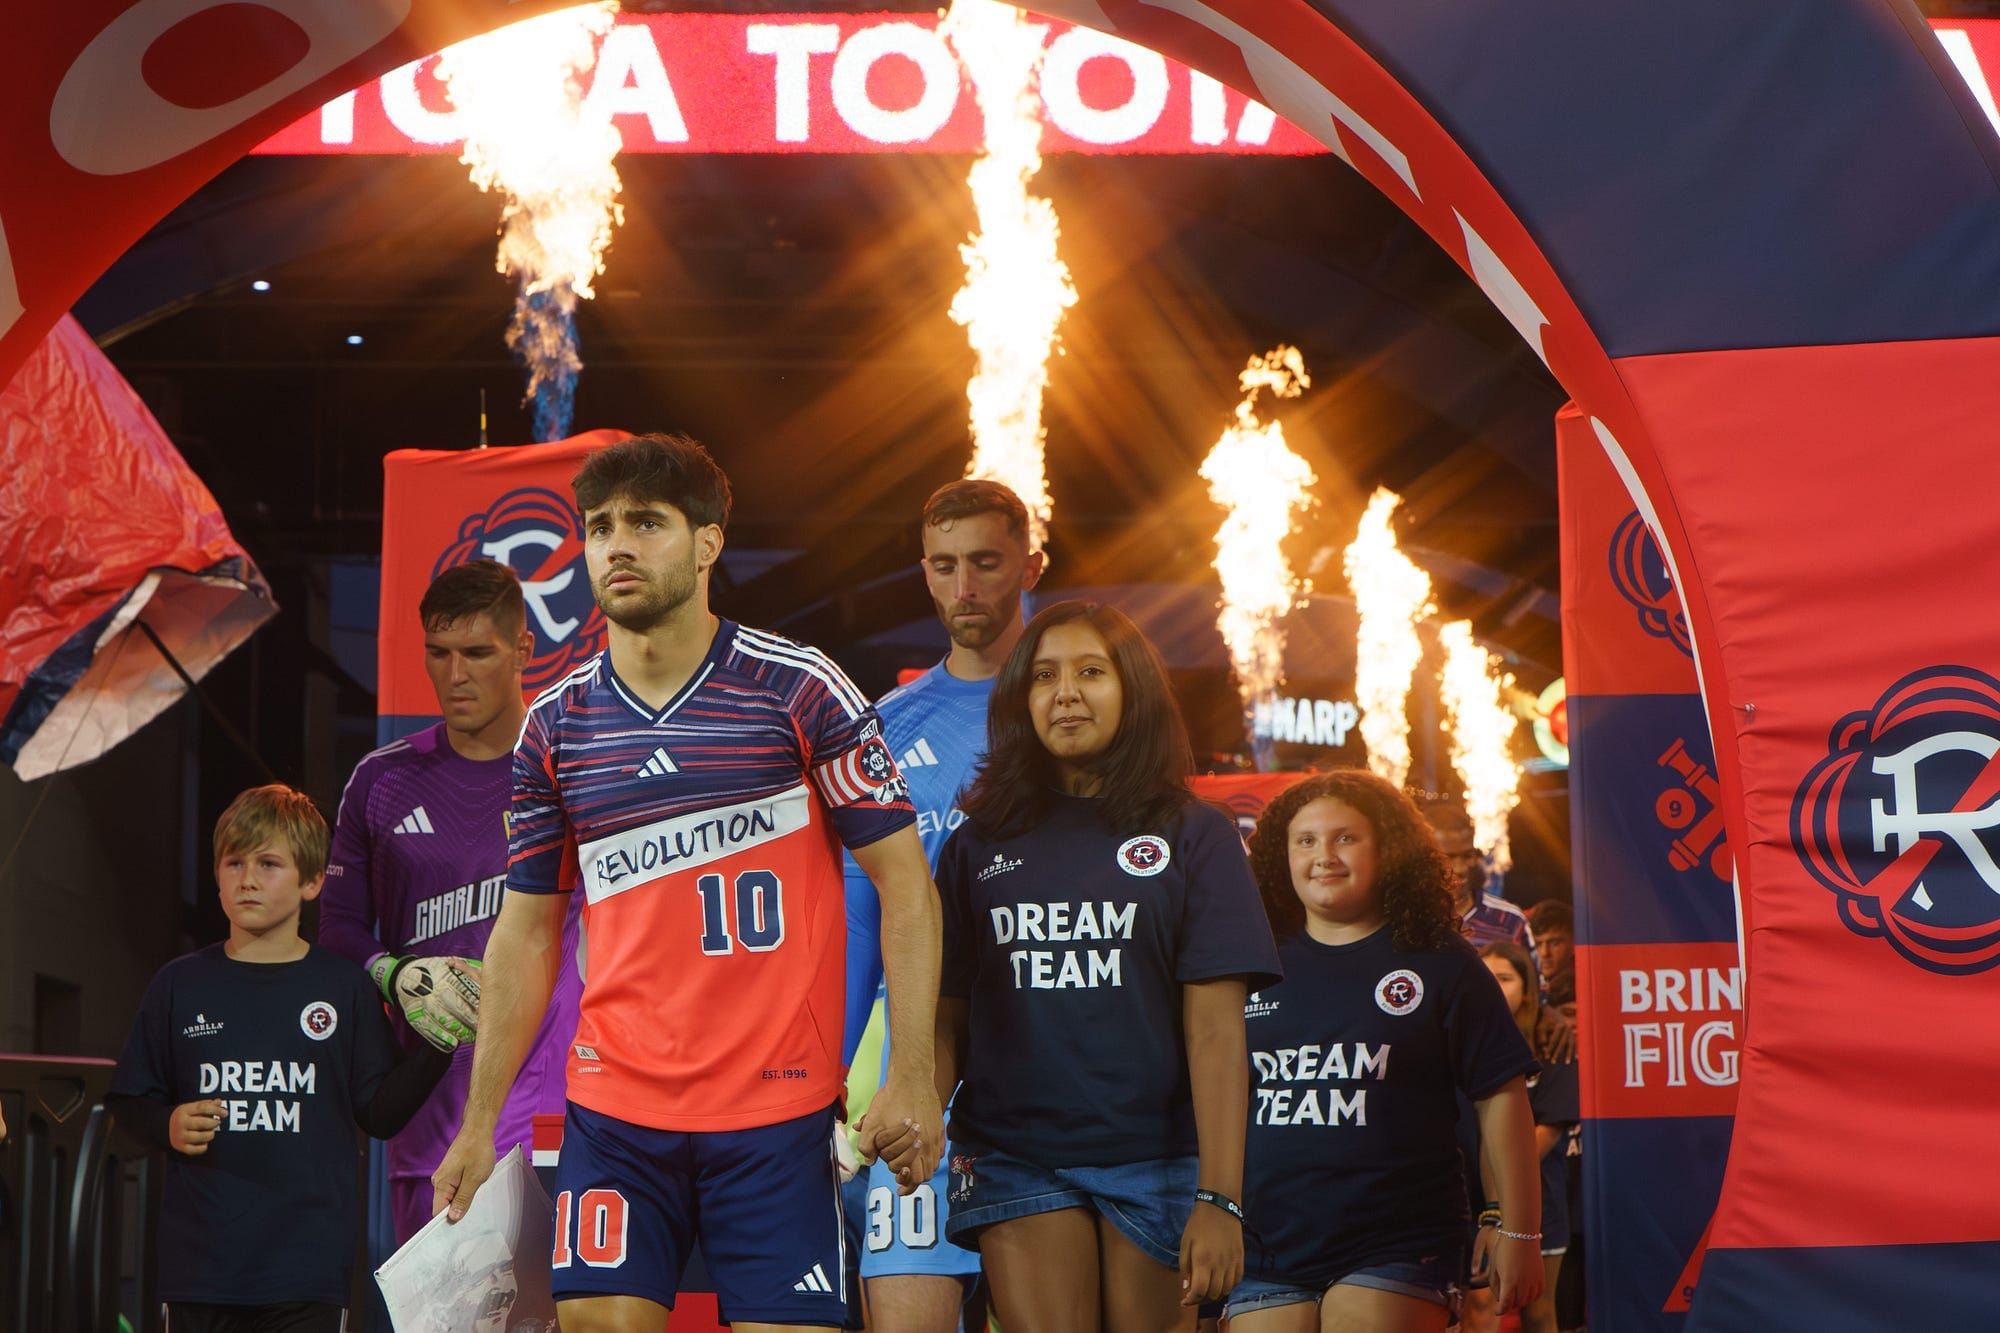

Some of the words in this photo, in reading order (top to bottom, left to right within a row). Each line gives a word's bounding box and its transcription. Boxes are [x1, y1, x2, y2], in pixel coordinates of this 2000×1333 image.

[917, 808, 969, 837] EVO
[597, 804, 775, 888] REVOLUTION
[697, 869, 785, 956] 10
[990, 901, 1138, 945] DREAM
[1010, 949, 1122, 989] TEAM
[200, 1060, 316, 1094] DREAM
[762, 1070, 780, 1080] EST.
[783, 1069, 807, 1079] 1996
[1252, 1043, 1392, 1083] DREAM
[1256, 1089, 1367, 1126] TEAM
[552, 1189, 629, 1268] 10
[867, 1184, 938, 1253] 30
